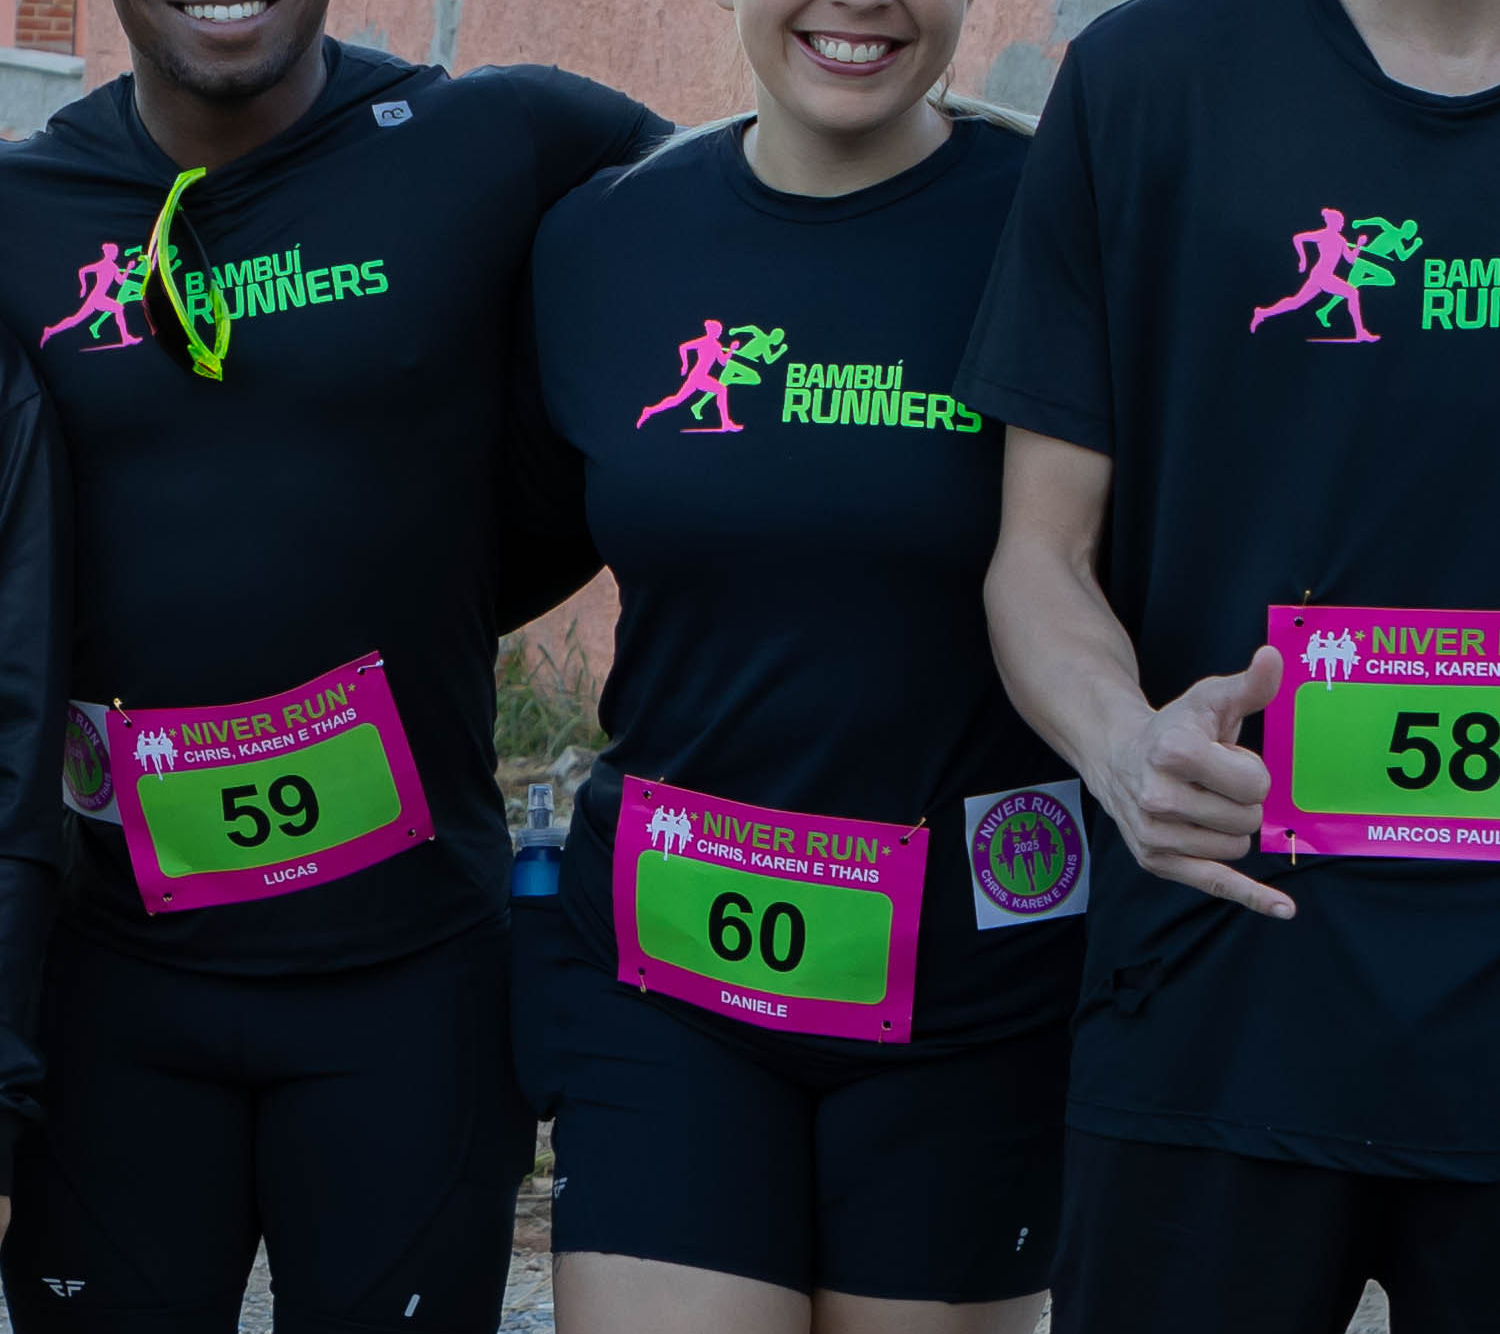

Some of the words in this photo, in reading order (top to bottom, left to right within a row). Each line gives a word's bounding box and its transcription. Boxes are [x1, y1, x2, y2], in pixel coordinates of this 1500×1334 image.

[187, 260, 389, 326] RUNNERS
[786, 359, 904, 389] BAMBUÍ
[1372, 626, 1485, 657] NIVER
[1366, 659, 1430, 679] CHRIS,
[1436, 661, 1500, 677] KAREN
[181, 713, 276, 746] NIVER
[282, 683, 349, 728] RUN
[184, 747, 236, 764] CHRIS,
[239, 733, 295, 758] KAREN
[298, 728, 310, 742] E
[314, 708, 357, 736] THAIS
[221, 775, 319, 848] 59
[980, 797, 1026, 839] NIVER
[1031, 797, 1066, 826] RUN
[703, 811, 795, 853] NIVER
[806, 831, 879, 863] RUN
[1014, 840, 1040, 853] 2025
[1367, 825, 1451, 844] MARCOS
[264, 863, 318, 886] LUCAS
[697, 839, 747, 865] CHRIS,
[751, 853, 808, 873] KAREN
[813, 861, 824, 875] E
[829, 864, 880, 883] THAIS
[1012, 895, 1052, 909] KAREN
[1052, 889, 1061, 899] E
[1057, 854, 1077, 889] THAIS
[708, 891, 806, 973] 60
[721, 991, 787, 1017] DANIELE
